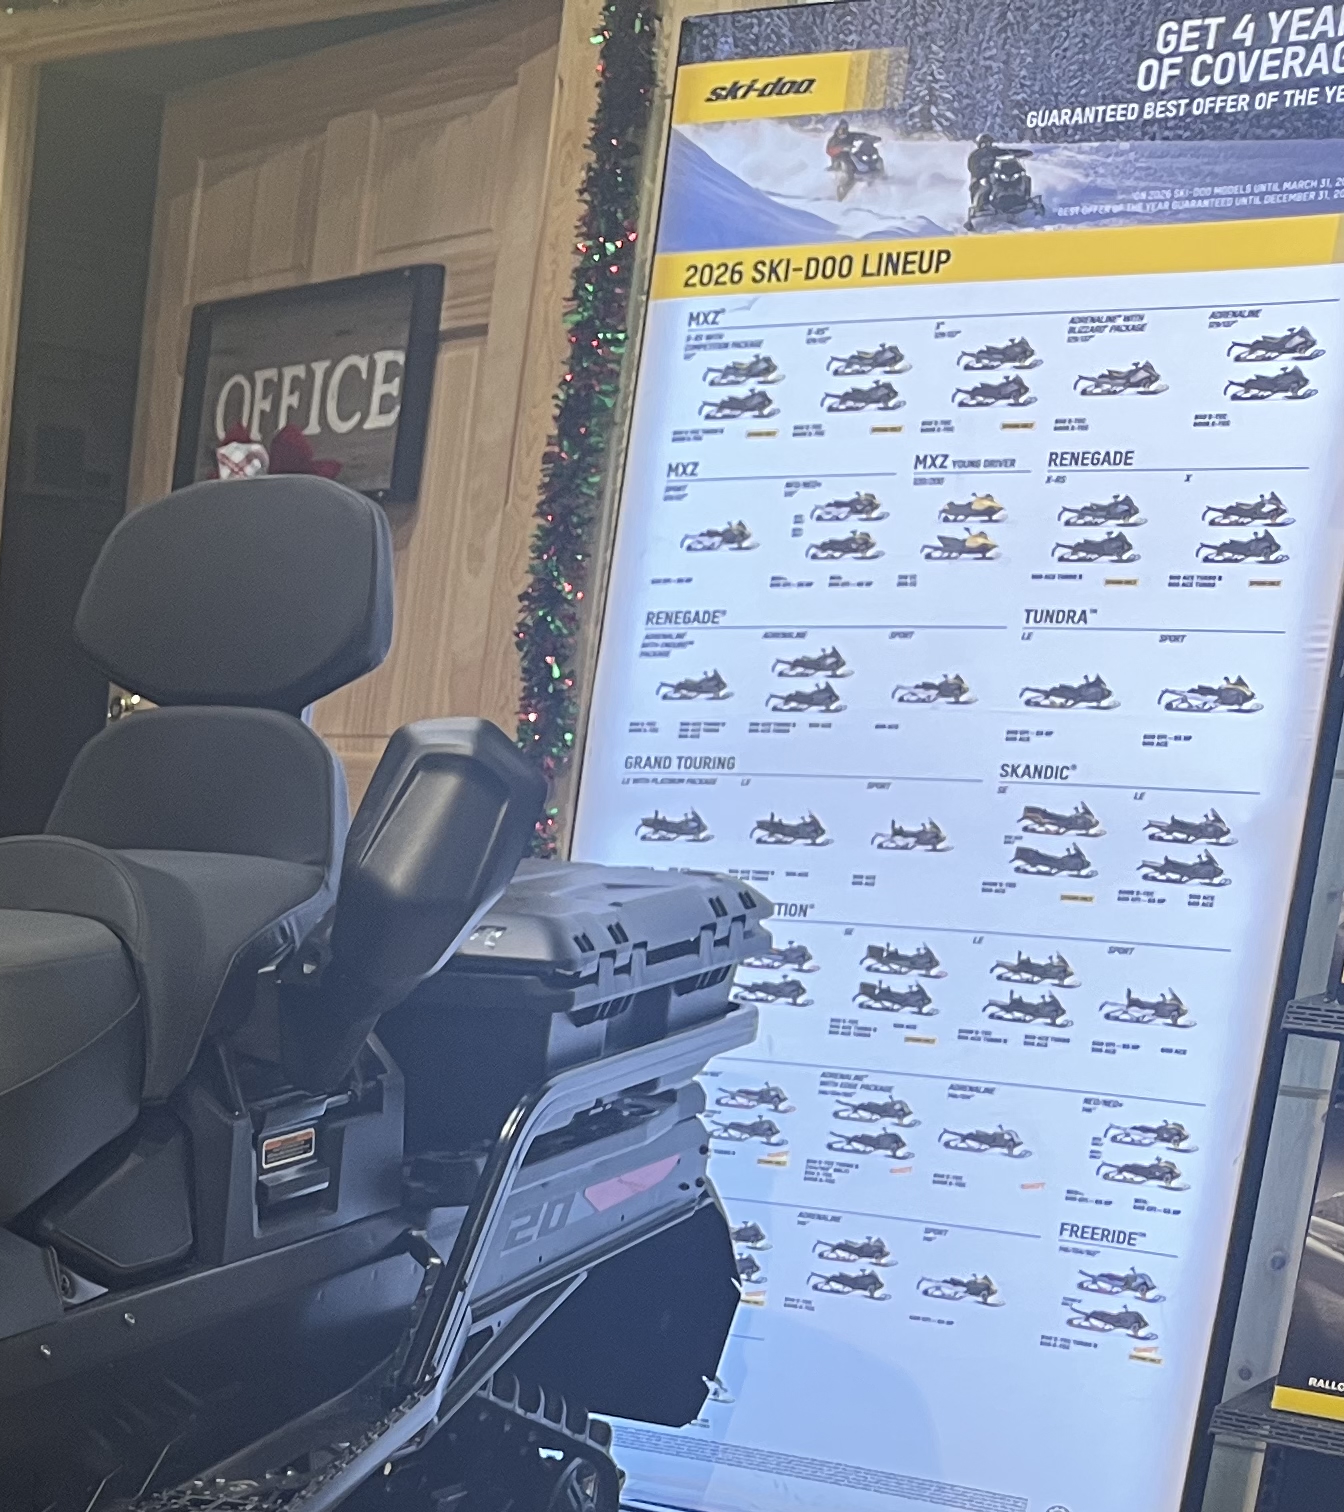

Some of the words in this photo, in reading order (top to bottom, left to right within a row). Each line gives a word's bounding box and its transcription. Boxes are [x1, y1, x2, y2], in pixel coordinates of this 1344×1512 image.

[1156, 15, 1226, 54] GET
[1232, 13, 1256, 47] 4
[1137, 56, 1183, 92] OF
[704, 76, 817, 103] ski-doo
[1026, 103, 1139, 128] GUARANTEED
[1143, 97, 1186, 119] BEST
[1192, 93, 1250, 116] OFFER
[1254, 91, 1280, 110] OF
[1284, 87, 1320, 107] THE
[1283, 179, 1318, 191] MARCH
[1235, 195, 1261, 207] UNTIL
[1263, 191, 1316, 205] DECEMBER
[683, 261, 744, 288] 2026
[751, 256, 854, 284] SKI-DOO
[862, 249, 952, 278] LINEUP
[215, 350, 406, 442] OFFICE
[914, 453, 949, 470] MXZ
[1048, 450, 1135, 467] RENEGADE
[666, 461, 700, 477] MXZ
[1045, 475, 1067, 485] X-RS
[1158, 634, 1188, 644] SPORT
[624, 756, 672, 770] GRAND
[676, 756, 736, 771] TOURING
[1107, 946, 1136, 955] SPORT
